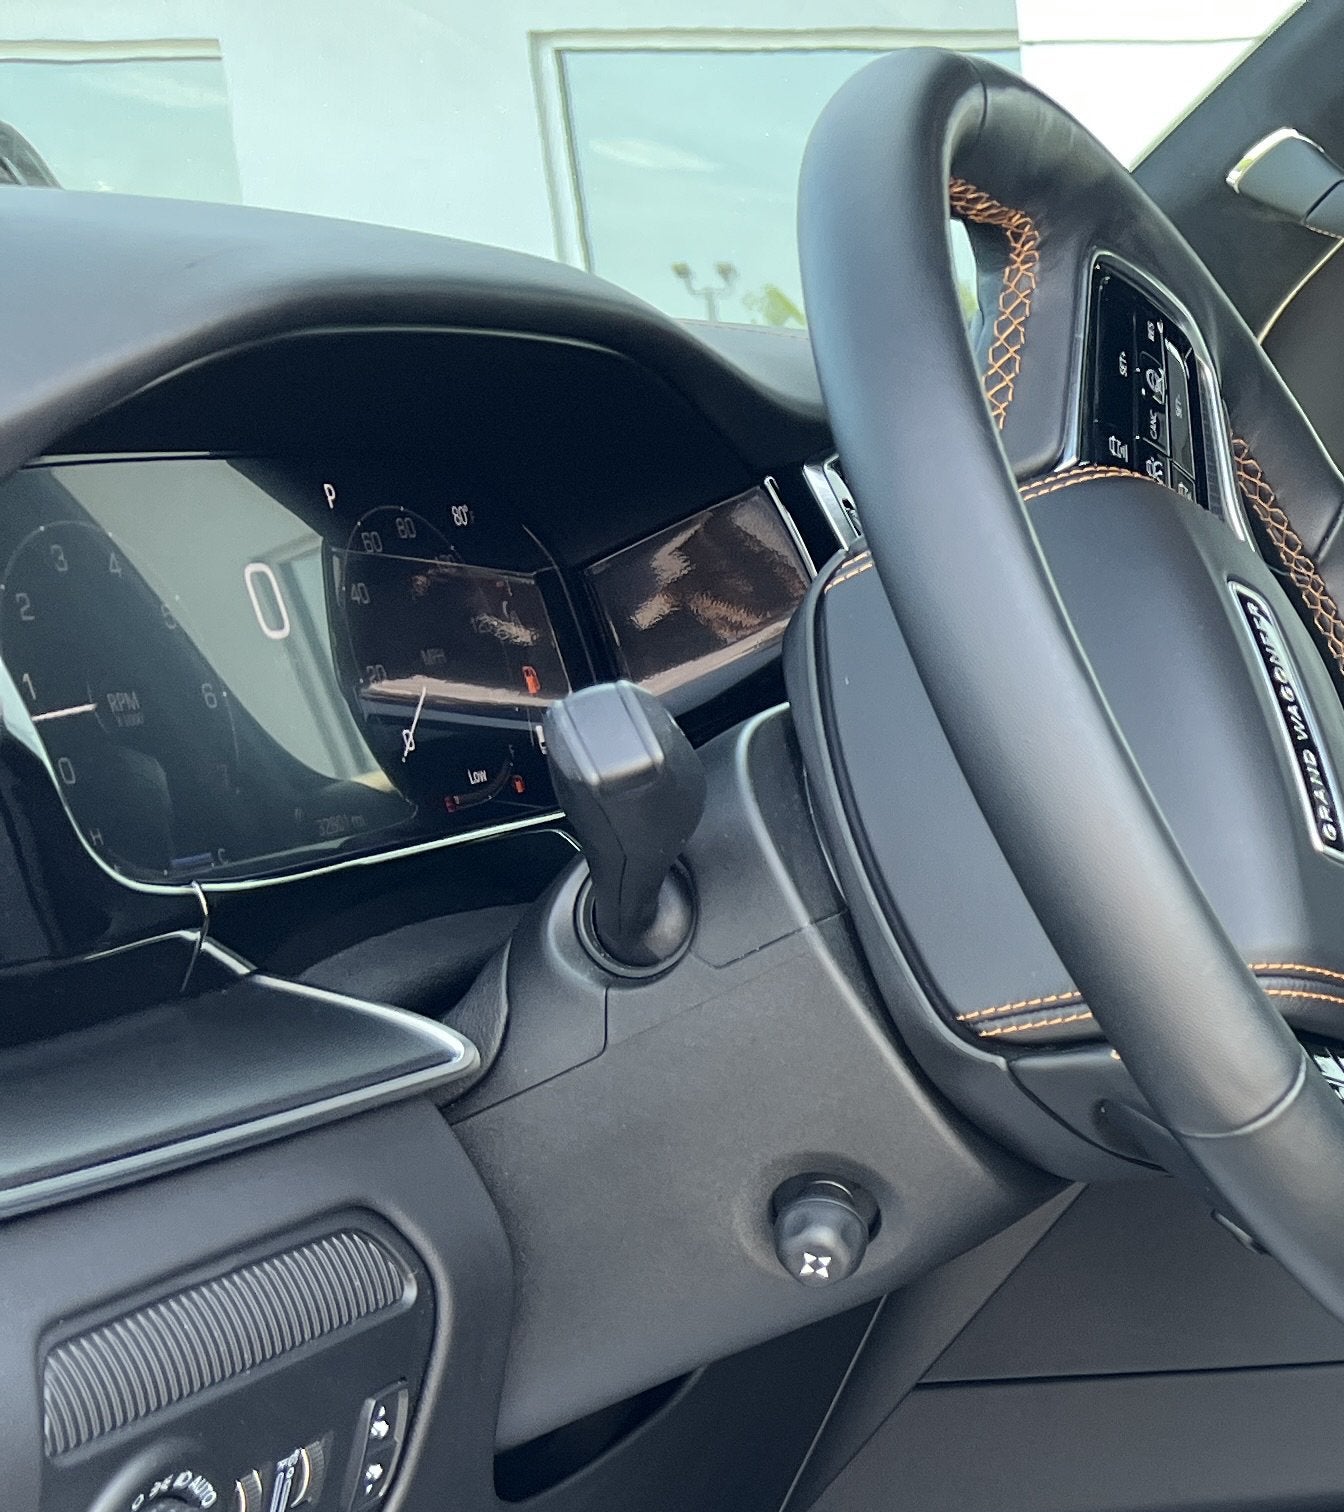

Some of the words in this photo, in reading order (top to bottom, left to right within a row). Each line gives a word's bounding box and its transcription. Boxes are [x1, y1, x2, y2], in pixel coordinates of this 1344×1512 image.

[323, 483, 336, 509] P
[243, 562, 291, 640] 0
[106, 690, 141, 713] RPM
[1302, 748, 1338, 842] GRAND
[188, 1475, 217, 1509] AUTO
